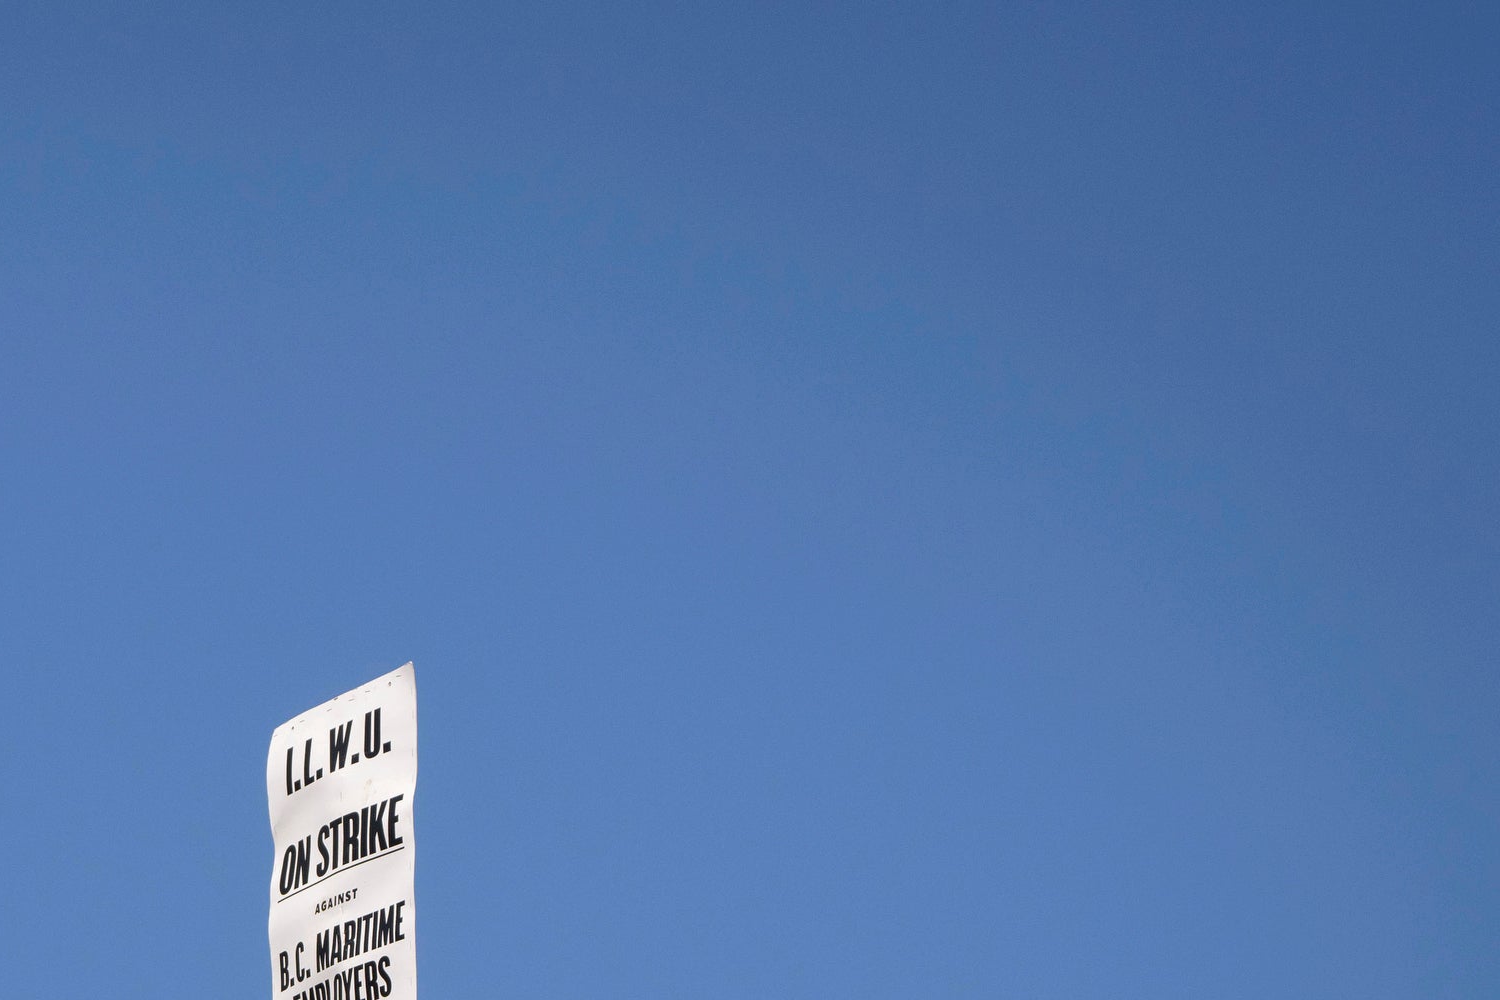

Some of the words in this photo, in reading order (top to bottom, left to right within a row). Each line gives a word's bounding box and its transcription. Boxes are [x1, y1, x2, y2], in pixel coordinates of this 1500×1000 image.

[286, 707, 392, 796] I.L.W.U.
[279, 835, 311, 896] ON
[316, 794, 404, 878] STRIKE
[279, 942, 311, 992] B.C.
[315, 900, 405, 974] MARITIME
[314, 888, 358, 915] AGAINST
